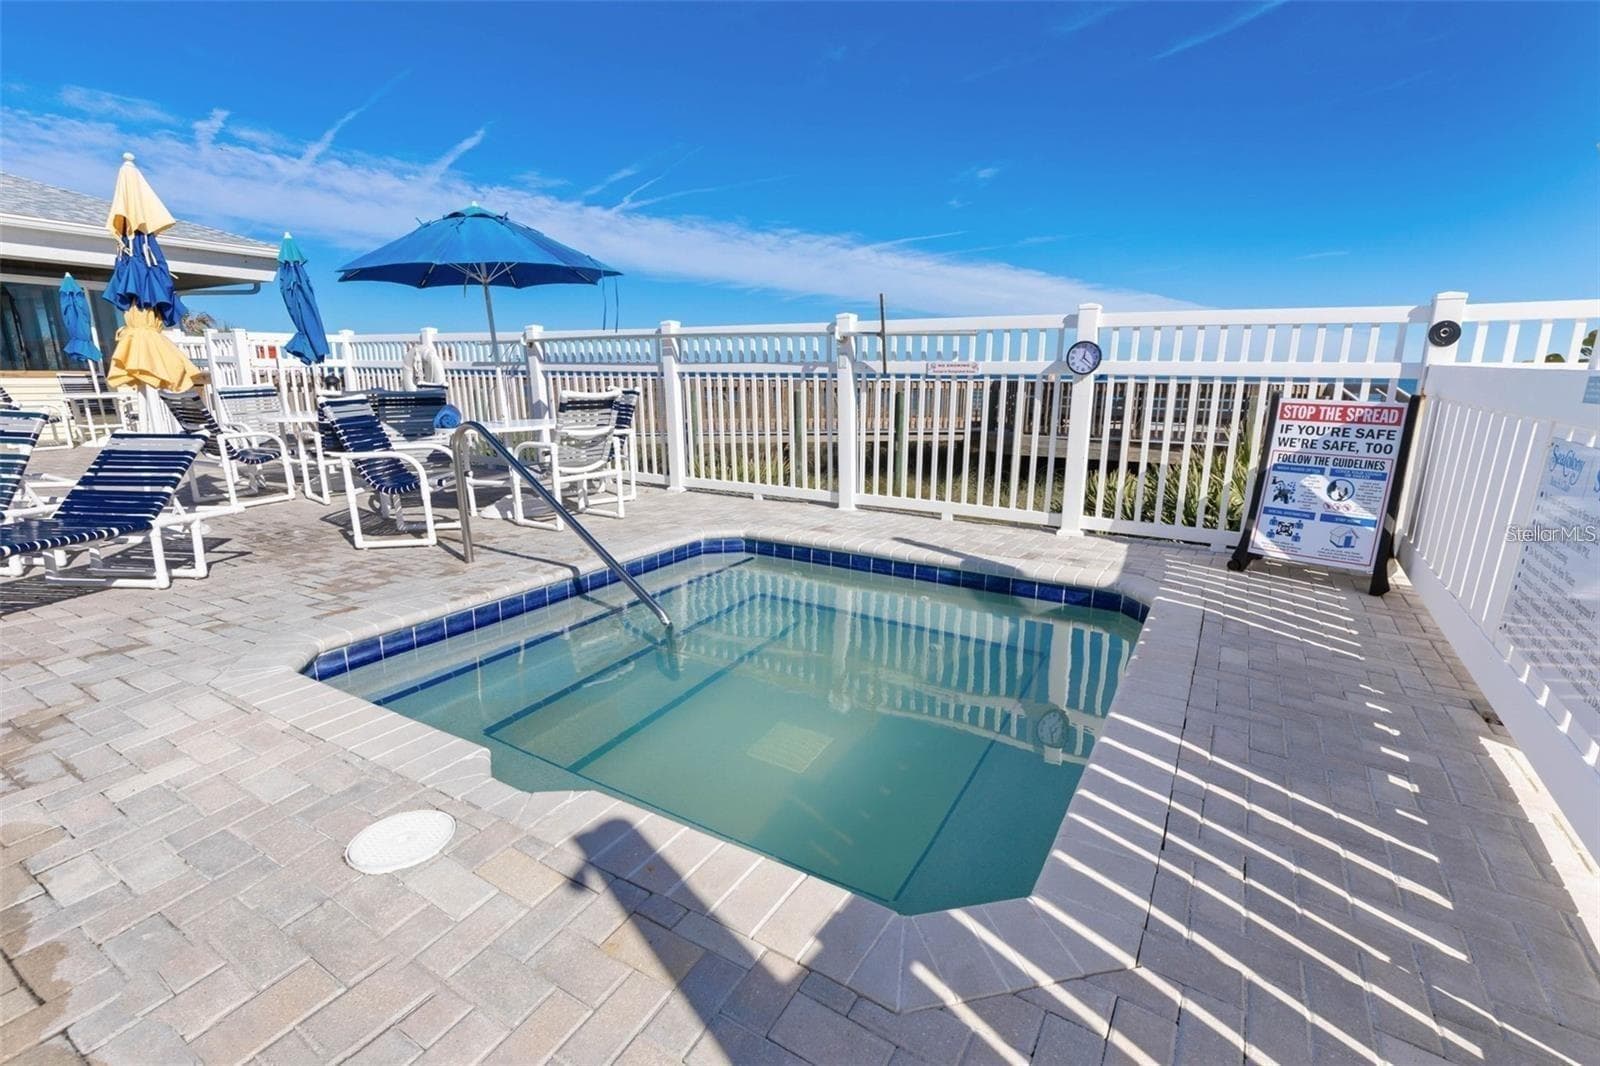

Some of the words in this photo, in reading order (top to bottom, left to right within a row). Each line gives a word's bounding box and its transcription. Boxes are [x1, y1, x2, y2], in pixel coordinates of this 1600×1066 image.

[1283, 404, 1316, 419] STOP
[1319, 406, 1344, 421] THE
[1346, 407, 1399, 424] SPREAD
[1280, 424, 1294, 434] IF
[1297, 424, 1351, 438] YOU'RE
[1355, 428, 1397, 440] SAFE
[1277, 437, 1318, 449] WE'RE
[1322, 440, 1360, 454] SAFE,
[1365, 442, 1393, 455] TOO
[1277, 453, 1312, 465] FOLLOW
[1313, 456, 1330, 467] THE
[1332, 457, 1386, 471] GUIDELINES
